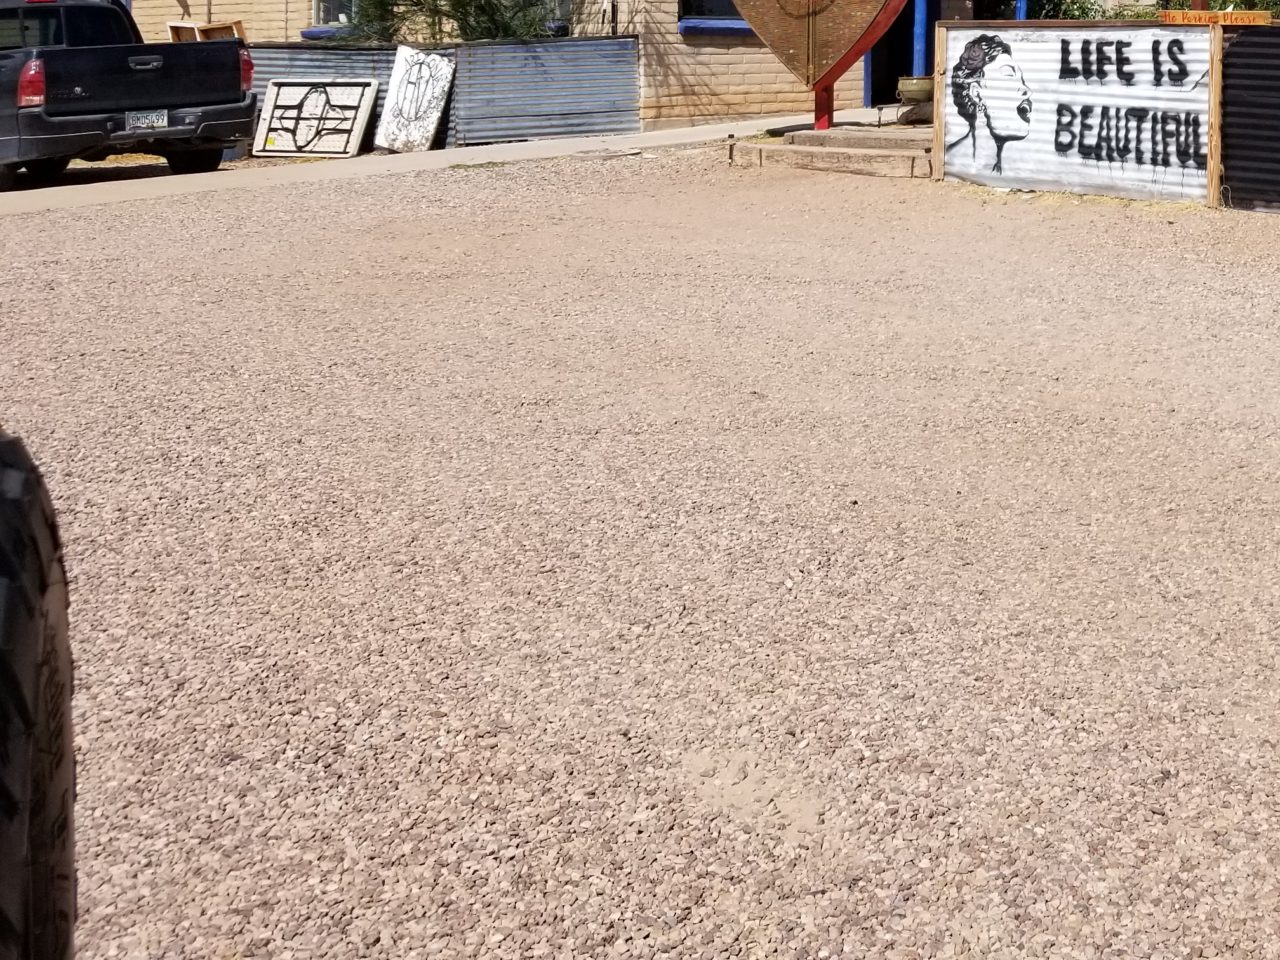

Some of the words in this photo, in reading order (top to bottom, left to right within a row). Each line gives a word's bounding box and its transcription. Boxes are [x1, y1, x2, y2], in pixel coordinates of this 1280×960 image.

[1059, 39, 1135, 86] LIFE
[1152, 39, 1189, 86] IS
[1055, 103, 1208, 170] BEAUTIFUL
